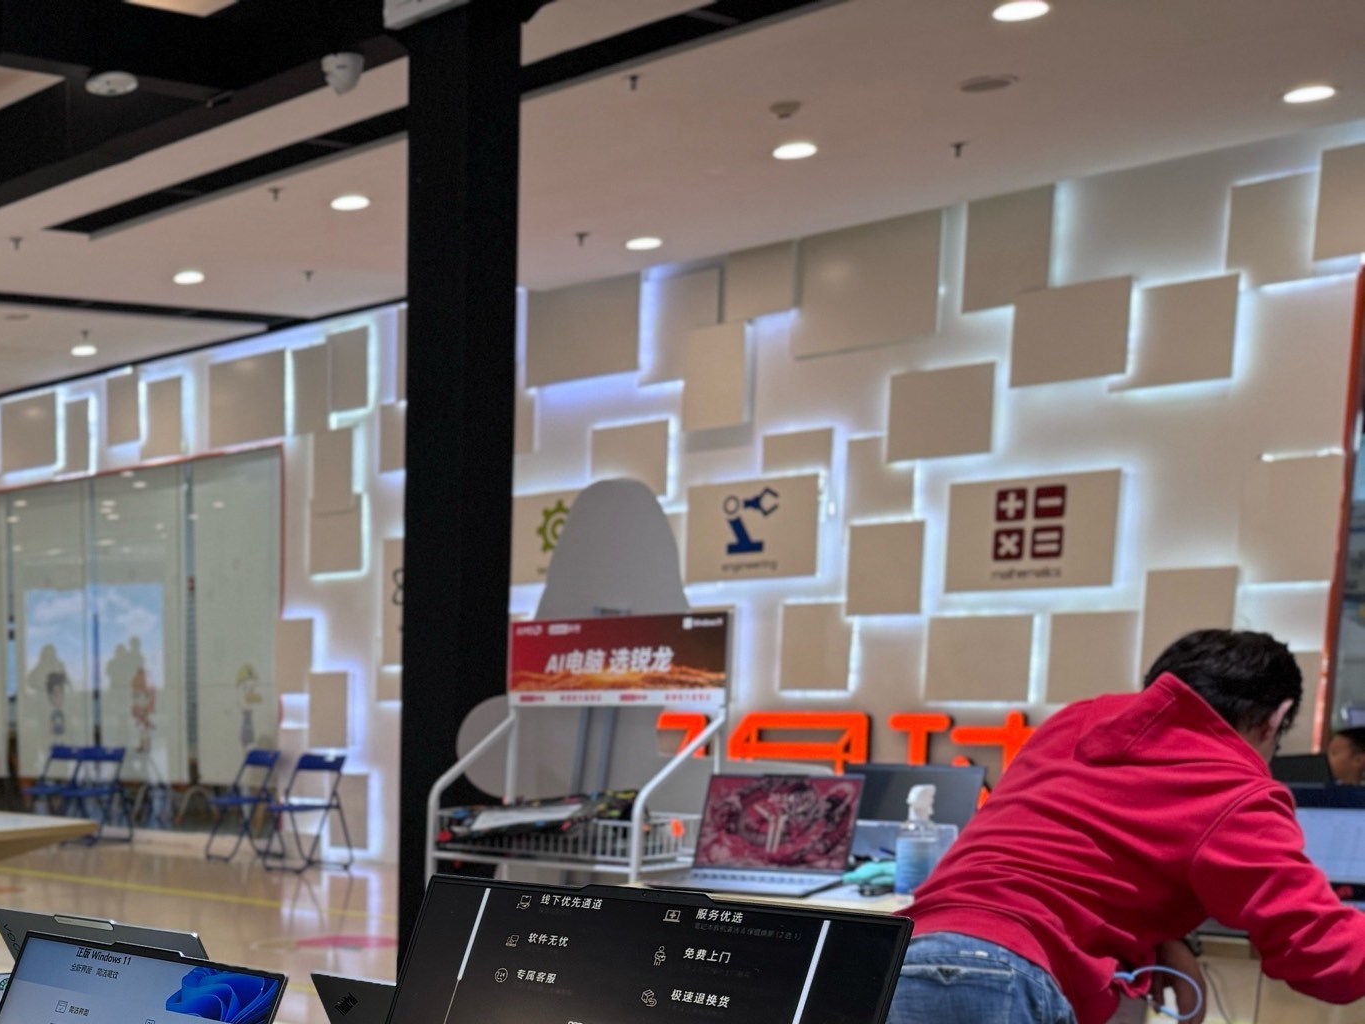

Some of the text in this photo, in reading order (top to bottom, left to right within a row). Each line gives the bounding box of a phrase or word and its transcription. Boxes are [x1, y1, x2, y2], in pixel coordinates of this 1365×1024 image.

[991, 566, 1062, 579] mathematics
[545, 645, 675, 674] AI电脑 选锐龙
[539, 894, 603, 910] 线下优先通道
[695, 908, 744, 924] 服务优选
[526, 932, 570, 947] 软件无忧
[75, 946, 132, 965] 正版 Windows 11
[682, 947, 732, 964] 免费上门
[69, 962, 93, 974] 全新界面
[514, 968, 557, 984] 专属客服
[669, 989, 731, 1008] 极速退换货
